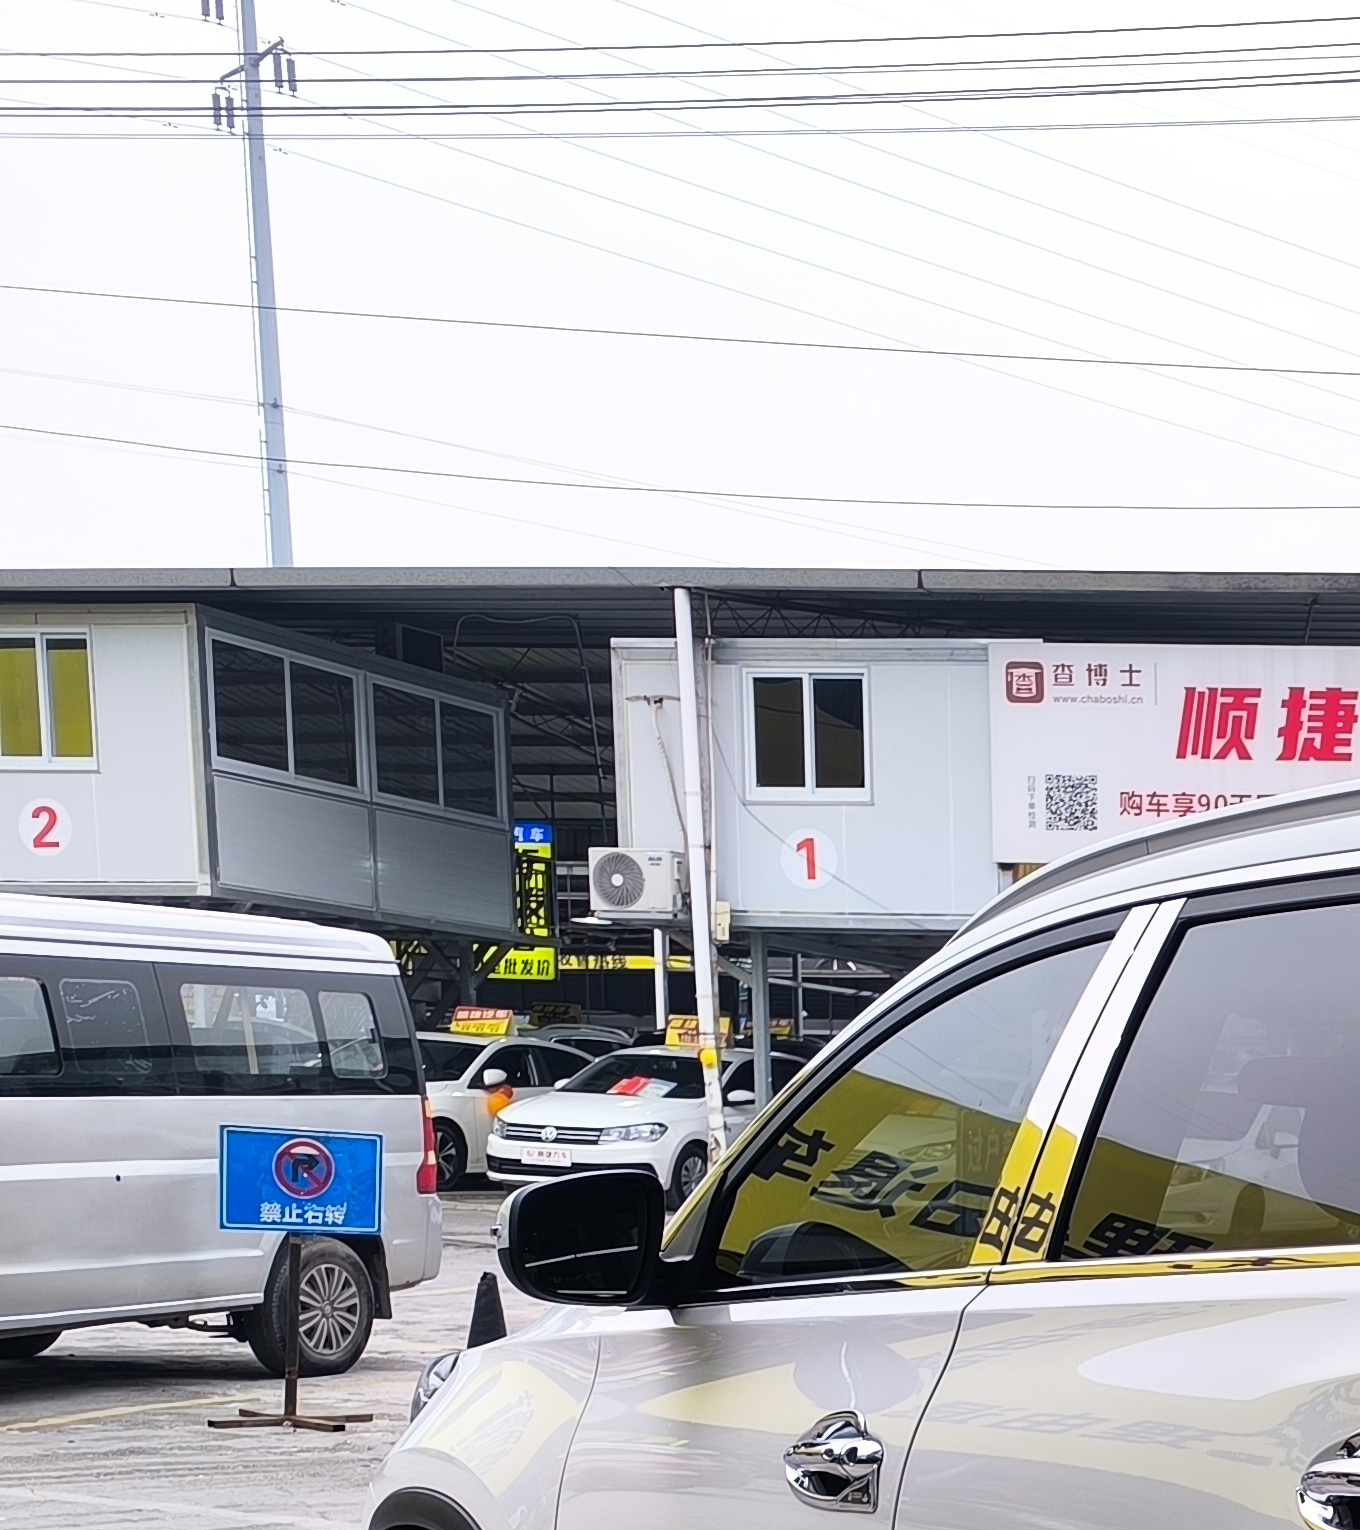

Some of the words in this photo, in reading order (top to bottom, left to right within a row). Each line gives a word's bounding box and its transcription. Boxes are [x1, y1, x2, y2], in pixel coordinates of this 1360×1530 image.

[1052, 662, 1142, 687] 查博士
[1052, 693, 1144, 705] www.chaboshi.cn
[1119, 791, 1277, 817] 购车享90
[31, 805, 60, 849] 2
[795, 837, 816, 880] 1
[495, 957, 551, 976] 批发价
[259, 1201, 348, 1226] 禁止右转
